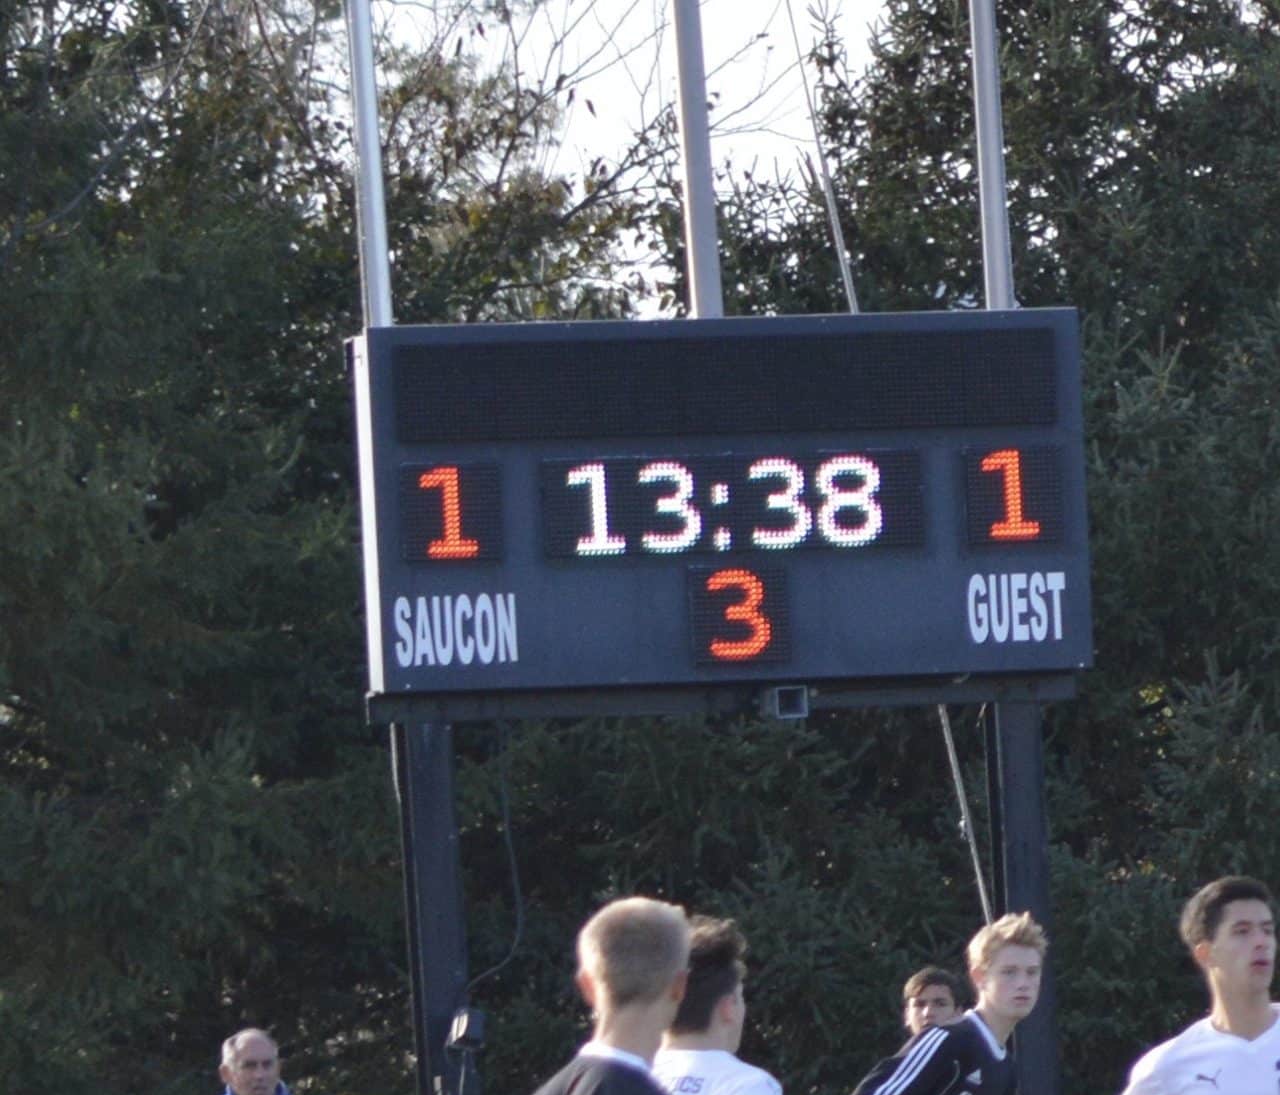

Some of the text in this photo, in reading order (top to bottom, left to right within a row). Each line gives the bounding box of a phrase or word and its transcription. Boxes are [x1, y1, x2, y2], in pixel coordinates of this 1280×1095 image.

[418, 465, 480, 560] 1
[566, 455, 883, 556] 13:38
[981, 450, 1040, 541] 1
[393, 593, 519, 668] SAUCON
[706, 568, 772, 661] 3
[967, 571, 1065, 644] GUEST
